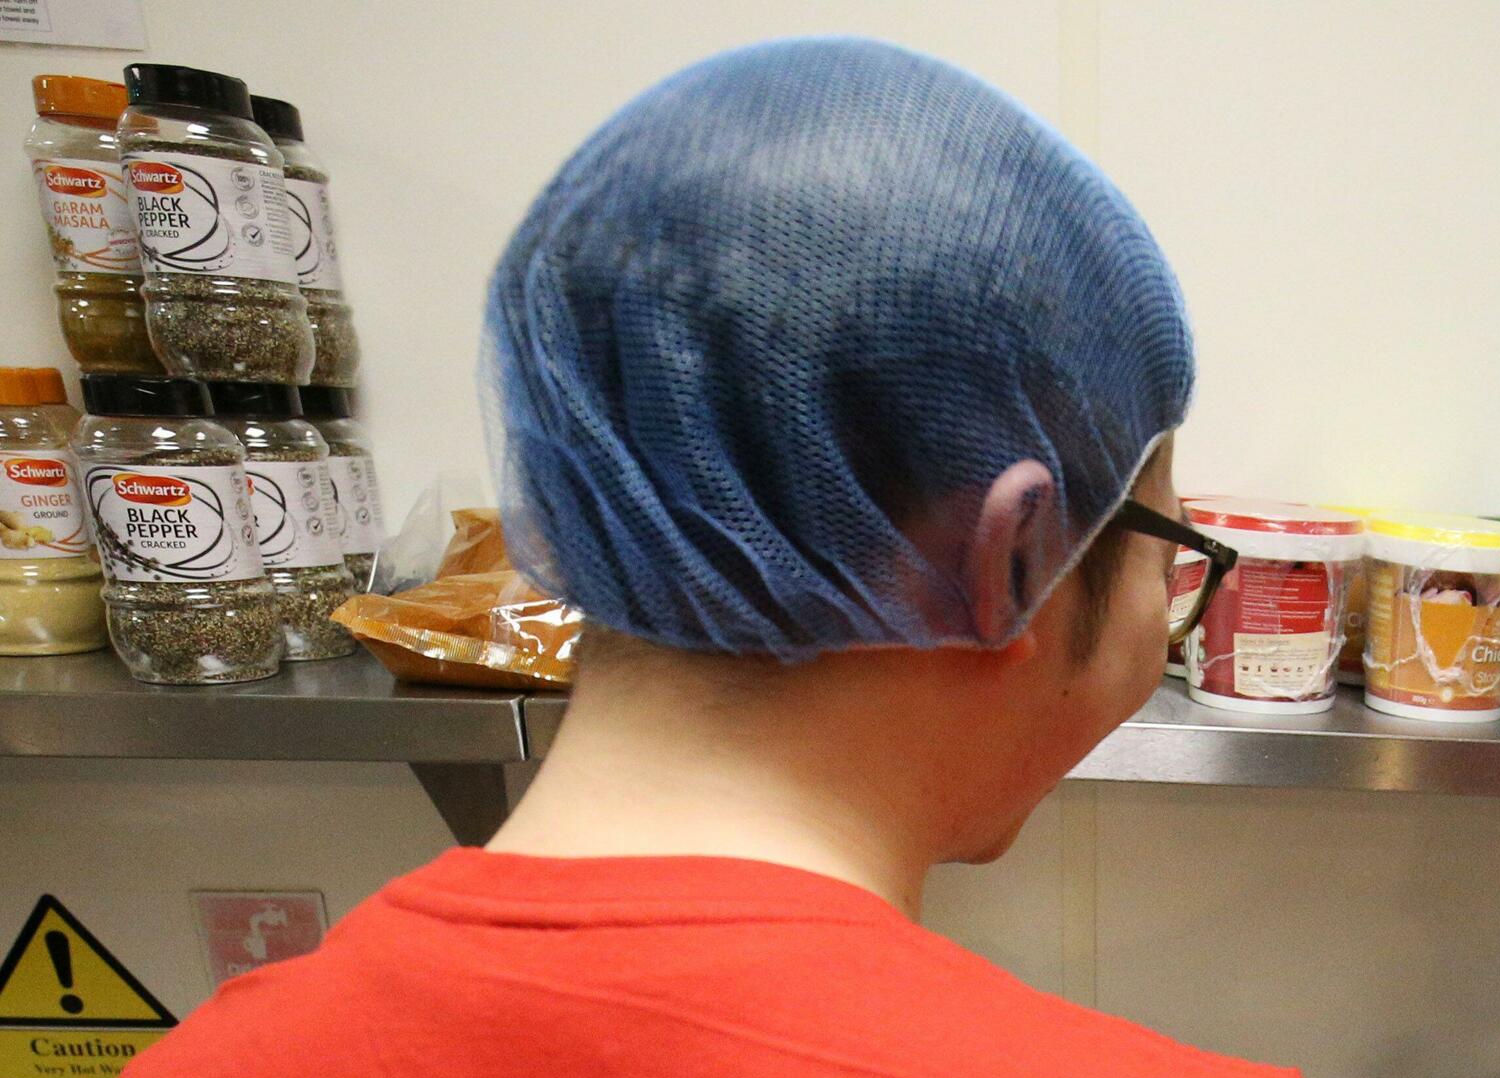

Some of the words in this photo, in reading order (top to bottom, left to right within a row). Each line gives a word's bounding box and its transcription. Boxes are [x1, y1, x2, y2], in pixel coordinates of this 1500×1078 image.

[46, 172, 102, 189] Schwartz
[132, 170, 179, 185] Schwartz
[53, 201, 104, 215] GARAM
[138, 196, 184, 212] BLACK
[53, 215, 111, 229] MASALA
[139, 212, 191, 228] PEPPER
[146, 229, 179, 239] CRACKED
[10, 464, 65, 478] Schwartz
[118, 480, 186, 497] Schwartz
[21, 493, 71, 507] GINGER
[33, 510, 69, 519] GROUND
[127, 507, 191, 523] BLACK
[126, 523, 198, 539] PEPPER
[140, 540, 186, 549] CRACKED
[30, 1038, 136, 1057] Caution
[34, 1063, 65, 1075] Very
[69, 1063, 95, 1074] Hot
